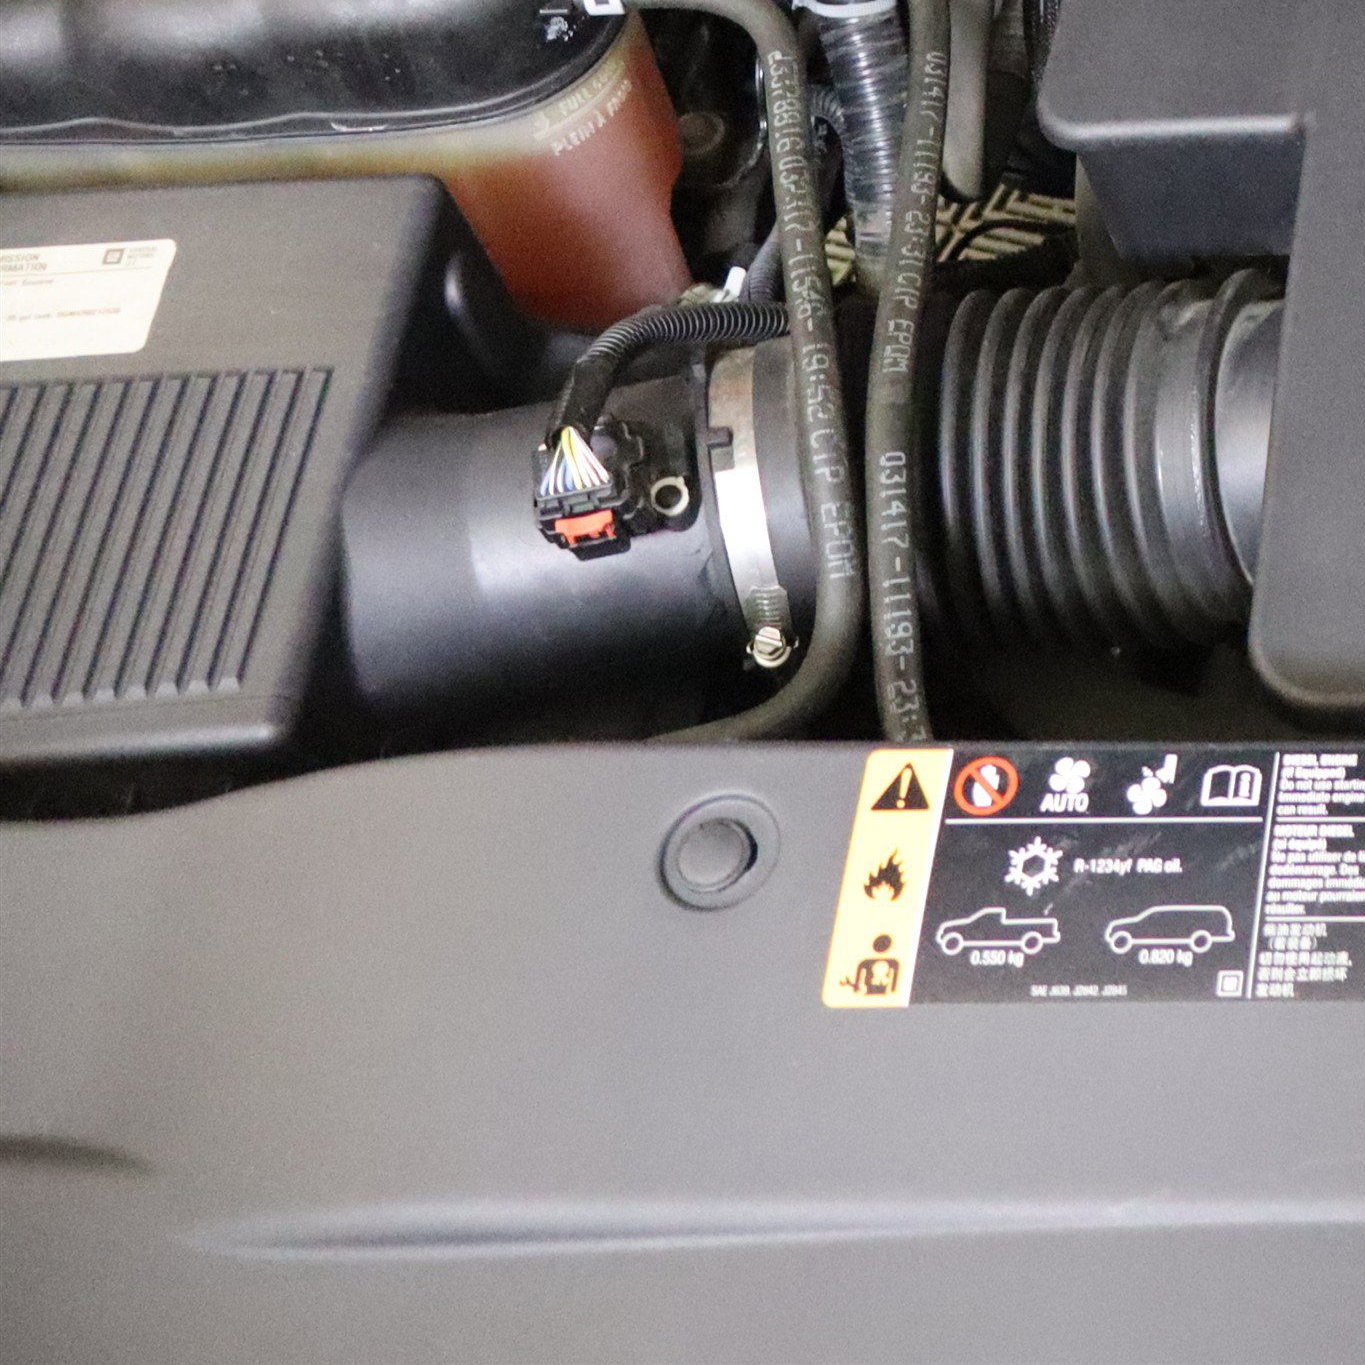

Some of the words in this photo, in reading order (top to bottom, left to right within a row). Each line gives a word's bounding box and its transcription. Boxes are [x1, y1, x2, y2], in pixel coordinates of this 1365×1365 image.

[1040, 793, 1089, 813] AUTO
[1007, 951, 1024, 968] kg
[1175, 950, 1193, 967] kg
